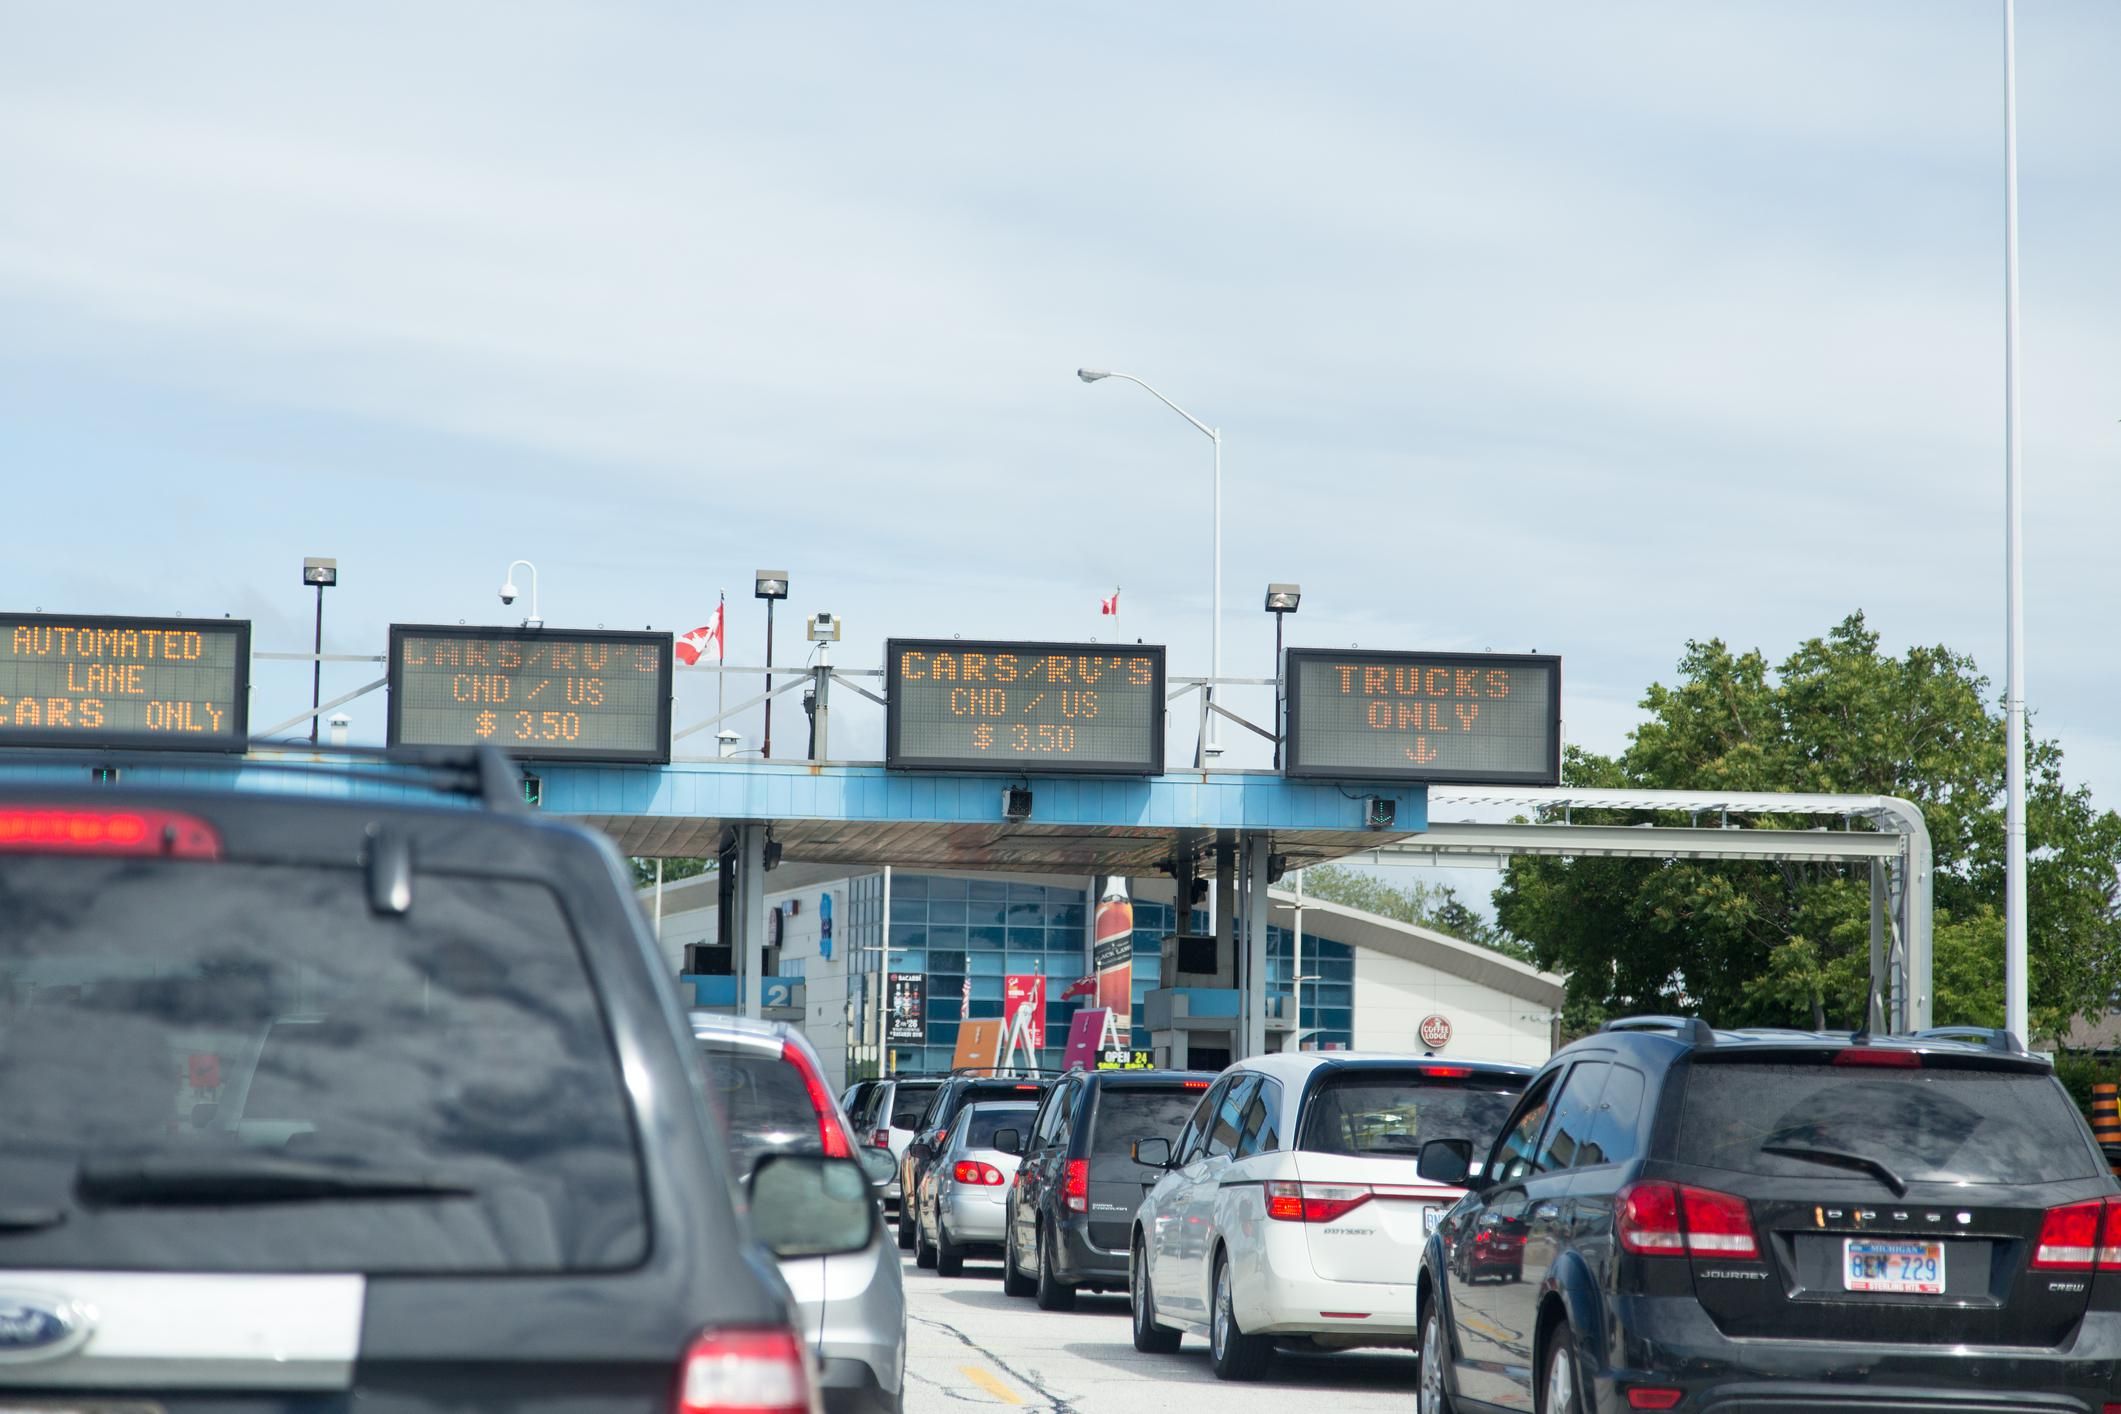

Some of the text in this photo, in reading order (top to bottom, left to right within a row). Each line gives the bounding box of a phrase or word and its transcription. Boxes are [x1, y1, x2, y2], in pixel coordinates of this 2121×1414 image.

[13, 626, 202, 660] AUTOMATED
[67, 663, 145, 694] LANE
[452, 674, 511, 703] CND
[566, 677, 605, 706] US
[1335, 665, 1511, 698] TRUCKS
[146, 700, 224, 733] ONLY
[951, 687, 1007, 716] CND
[1062, 690, 1099, 718] US
[1368, 701, 1479, 732] ONLY
[474, 709, 581, 741] $ 3.50
[973, 723, 1076, 753] $ 3.50
[767, 984, 789, 1007] 2
[1104, 1050, 1148, 1064] OPEN 24
[1871, 1244, 1919, 1253] MICHIGAN
[1700, 1270, 1769, 1280] JOURNEY
[1901, 1256, 1937, 1281] Z29
[2048, 1282, 2085, 1292] CREW
